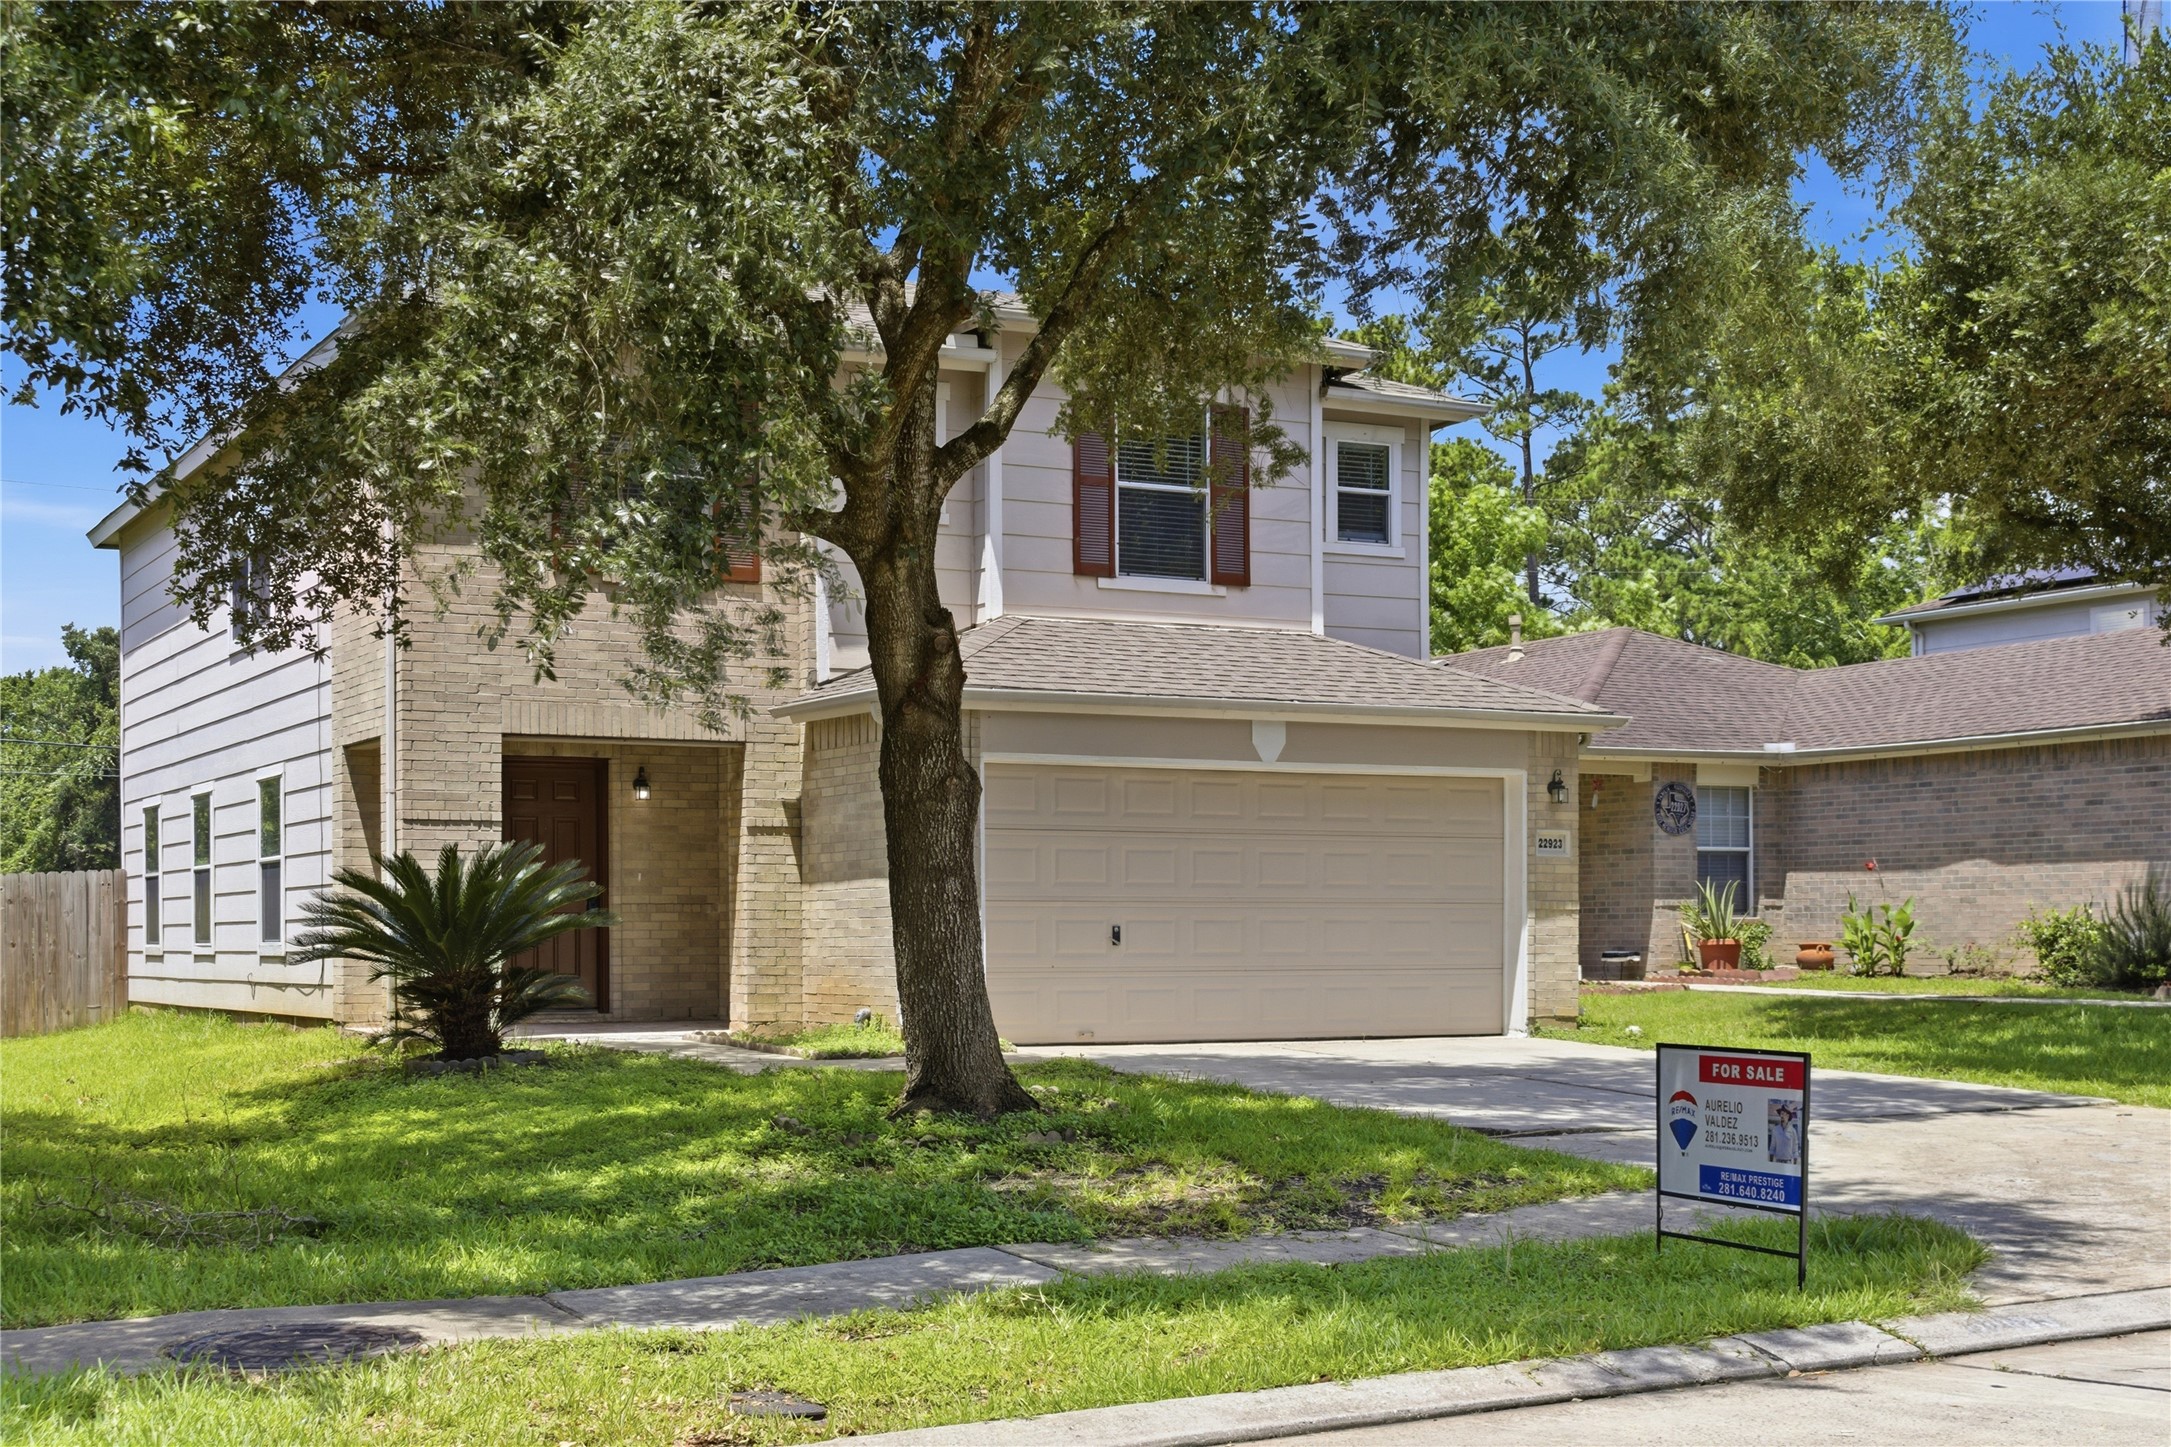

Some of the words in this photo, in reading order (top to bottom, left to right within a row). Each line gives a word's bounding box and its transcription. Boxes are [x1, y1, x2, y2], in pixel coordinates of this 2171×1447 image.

[1538, 838, 1563, 849] 22923
[1712, 1063, 1741, 1079] FOR
[1746, 1065, 1785, 1082] SALE
[1671, 1106, 1697, 1118] RE/MAX
[1705, 1099, 1743, 1114] AURELIO
[1705, 1115, 1738, 1130] VALDEZ
[1705, 1131, 1758, 1147] 281.236.9513
[1720, 1171, 1747, 1184] RE/MAX
[1749, 1175, 1784, 1189] PRESTIGE
[1719, 1182, 1785, 1202] 281.640.8240
